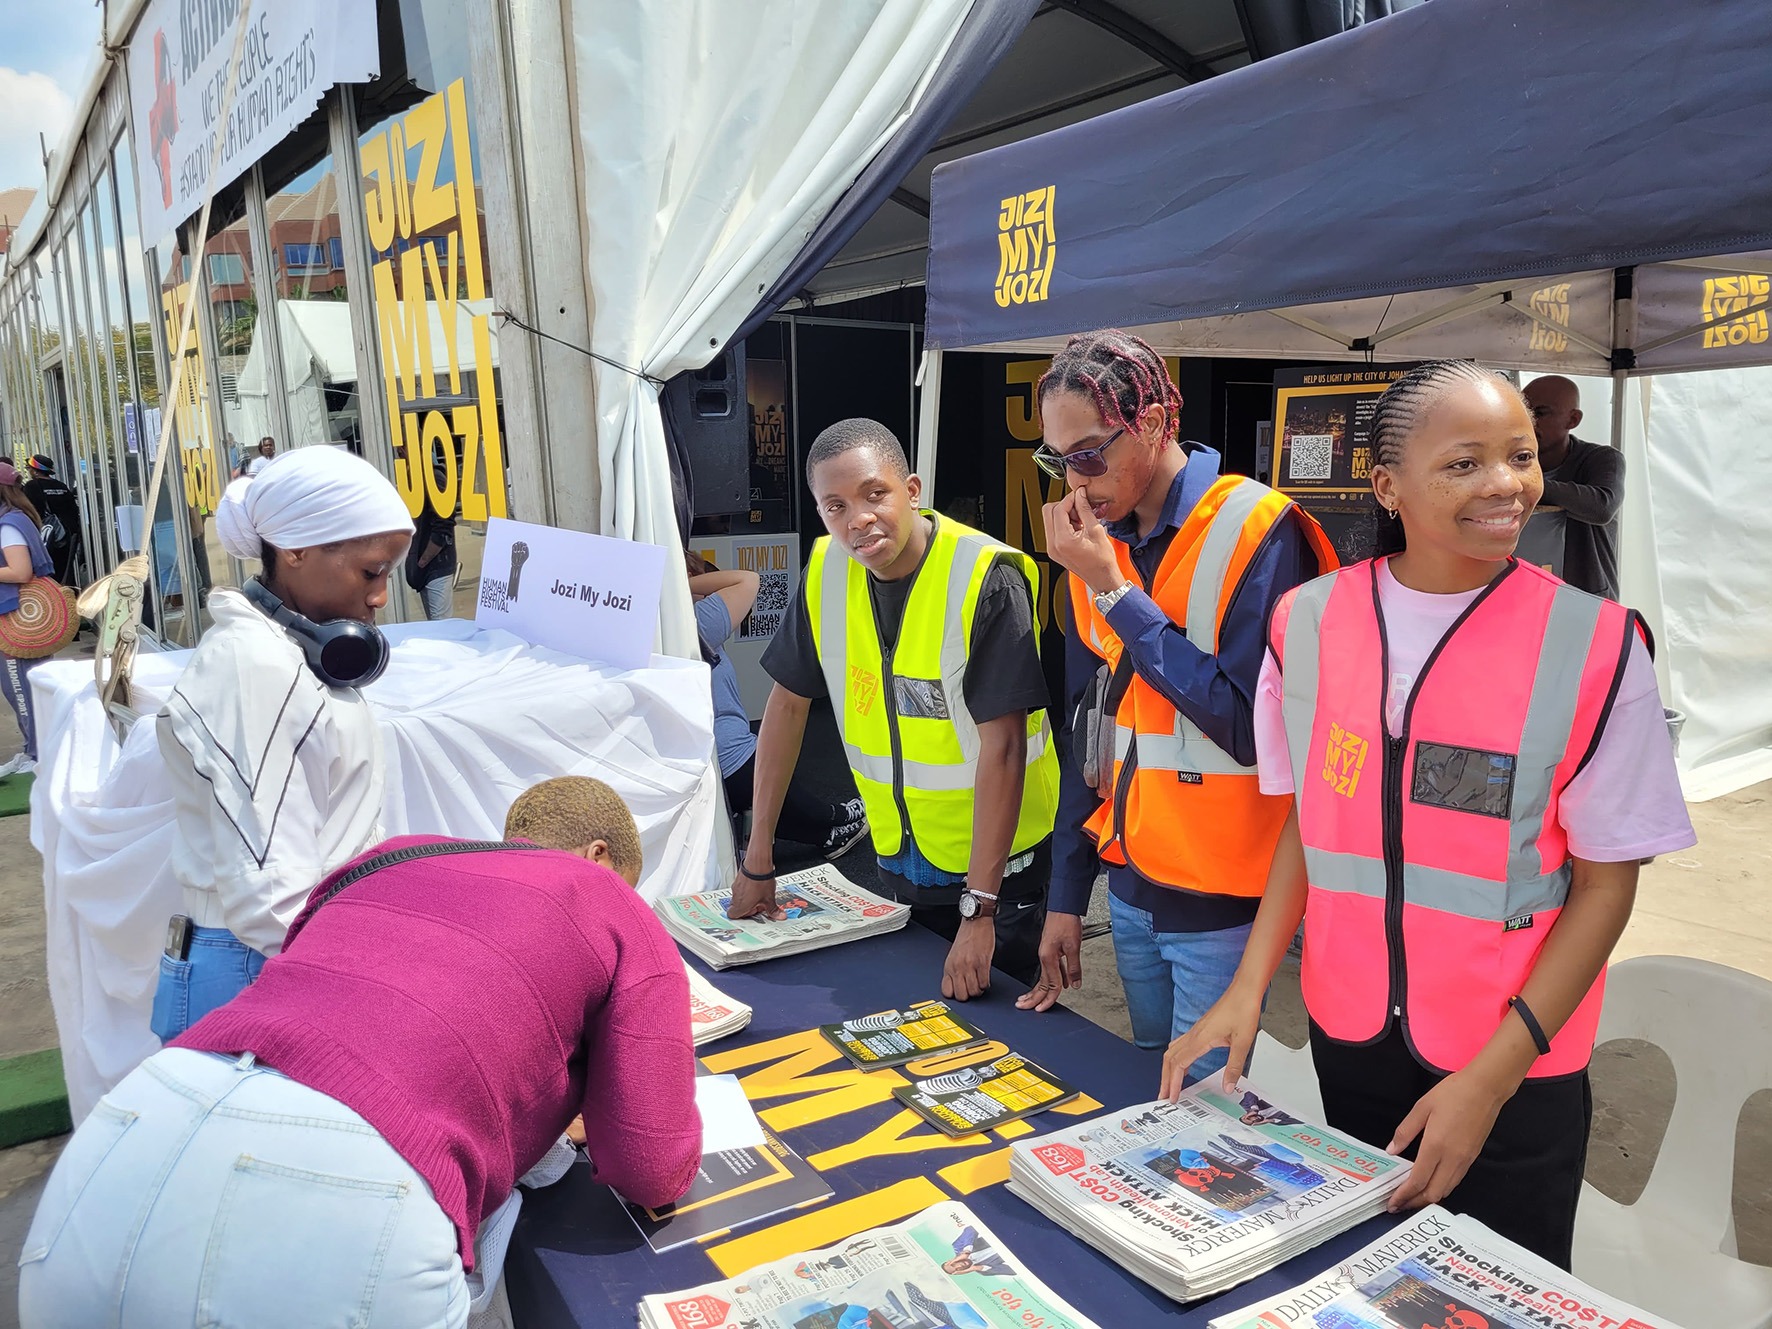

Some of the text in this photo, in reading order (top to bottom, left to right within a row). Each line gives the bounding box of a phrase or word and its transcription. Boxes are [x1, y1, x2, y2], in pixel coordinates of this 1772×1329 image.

[359, 77, 486, 300] JOZI
[995, 223, 1044, 287] MY
[994, 244, 1056, 308] JOZI
[373, 231, 462, 446] MY
[1304, 375, 1318, 384] HELP
[1318, 374, 1326, 383] US
[1327, 373, 1343, 383] LIGHT
[1344, 373, 1351, 382] UP
[1353, 373, 1363, 381] THE
[1364, 372, 1378, 381] CITY
[1379, 371, 1387, 380] OF
[394, 316, 507, 522] JOZI
[756, 546, 770, 572] MY
[771, 544, 788, 570] JOZI
[482, 577, 507, 592] HUMAN
[482, 587, 507, 601] RIGHTS
[551, 579, 632, 611] Jozi My Jozi
[480, 599, 509, 613] FESTIVAL
[750, 613, 780, 624] HUMAN
[16, 693, 28, 716] SPORT
[1325, 740, 1358, 775] MY
[1180, 772, 1200, 780] WATT
[1322, 767, 1362, 799] JOZI
[776, 867, 830, 887] AVERICK
[1508, 915, 1532, 928] WATT
[1291, 1131, 1325, 1146] tjo!
[1320, 1144, 1352, 1159] tjo,
[1038, 1146, 1074, 1170] 168
[1349, 1156, 1383, 1173] Tjo,
[1065, 1168, 1196, 1243] Shocking CO$T
[1085, 1164, 1209, 1235] of National Health Lab
[1097, 1159, 1222, 1229] HACK ATTACK
[1176, 1176, 1359, 1257] DAILY MAVERICK
[1272, 1215, 1454, 1321] DAILY MAVERICK
[1411, 1251, 1492, 1292] HACK
[1423, 1245, 1448, 1257] of
[1441, 1255, 1515, 1293] National
[1509, 1290, 1569, 1320] Health
[1433, 1235, 1622, 1329] Shocking CO$T
[674, 1299, 710, 1329] 168
[989, 1287, 1049, 1329] tjo, tjo!
